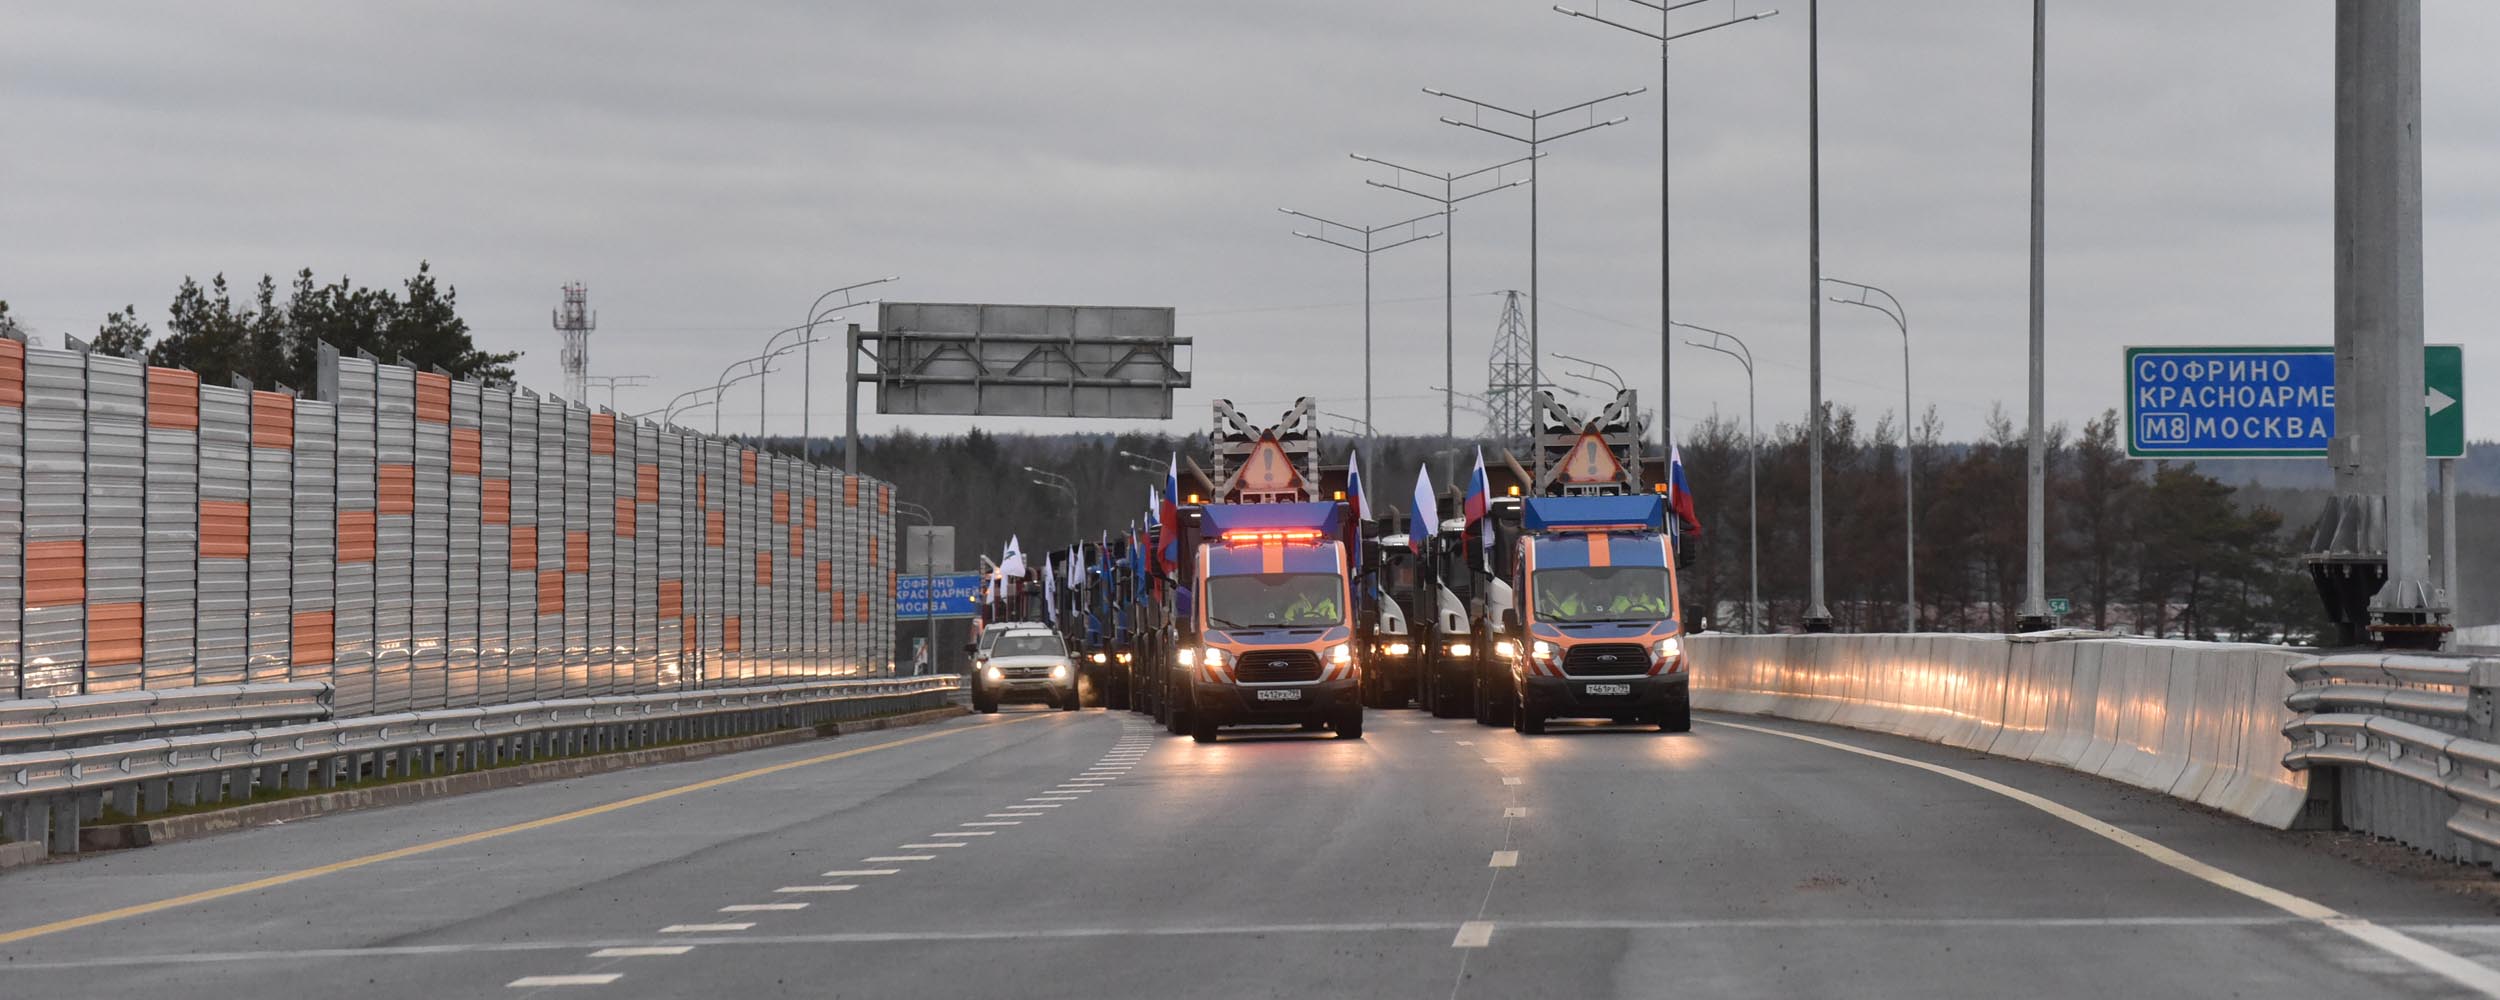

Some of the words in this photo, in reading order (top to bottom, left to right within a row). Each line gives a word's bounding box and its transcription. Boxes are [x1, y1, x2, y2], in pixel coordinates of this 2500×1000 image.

[2140, 360, 2290, 382] СОФРИНО
[2140, 386, 2335, 408] КРАСНОАРМЕ
[2146, 417, 2185, 439] М8
[2194, 417, 2327, 439] МОСКВА
[2051, 601, 2065, 611] 54
